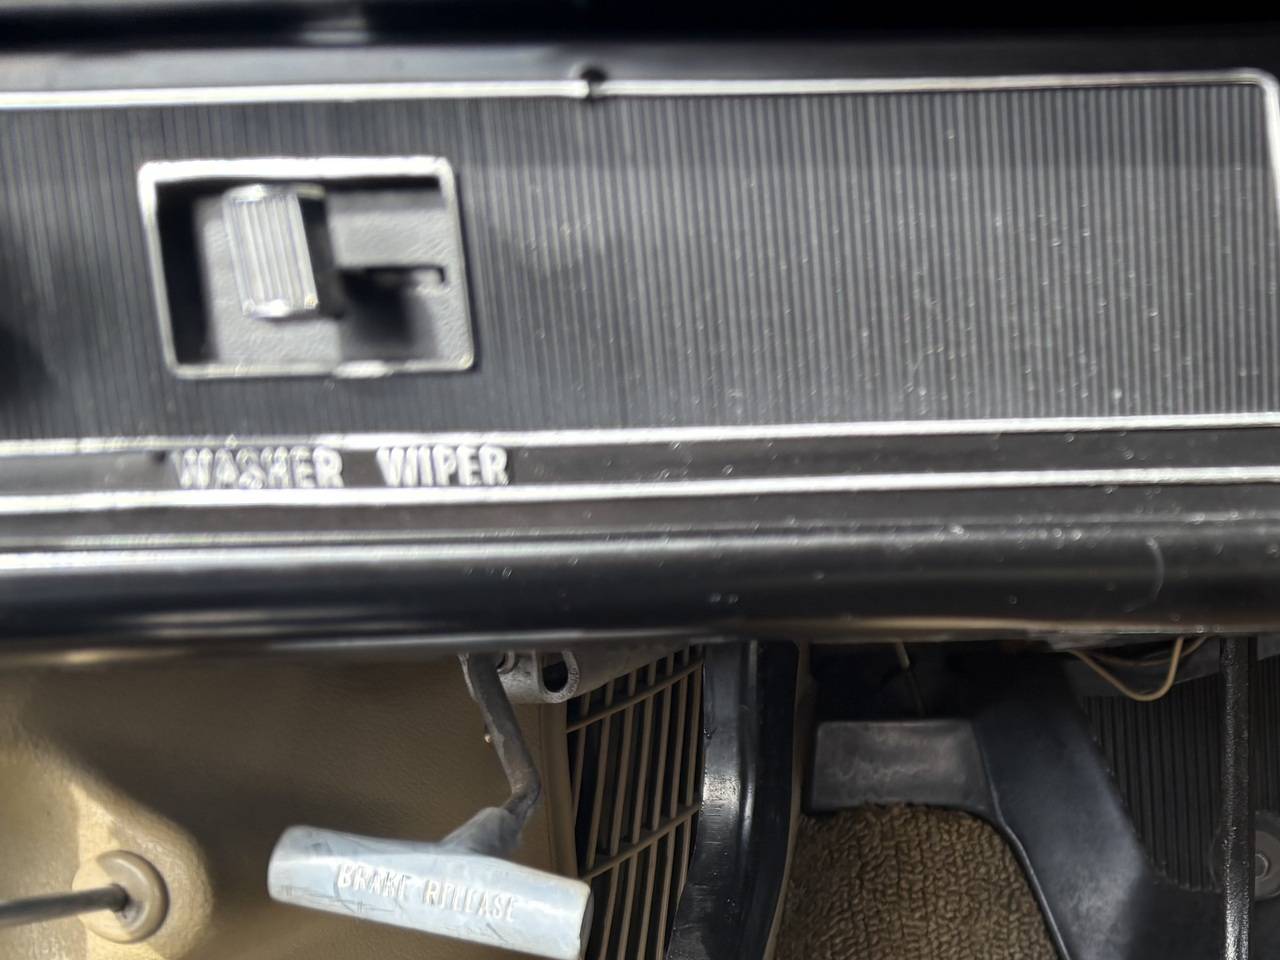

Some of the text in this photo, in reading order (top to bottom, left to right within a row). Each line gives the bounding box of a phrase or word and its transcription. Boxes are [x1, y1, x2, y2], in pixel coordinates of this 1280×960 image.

[170, 443, 511, 490] WASHER WIPER
[336, 862, 516, 922] BRAKE RELEASE
